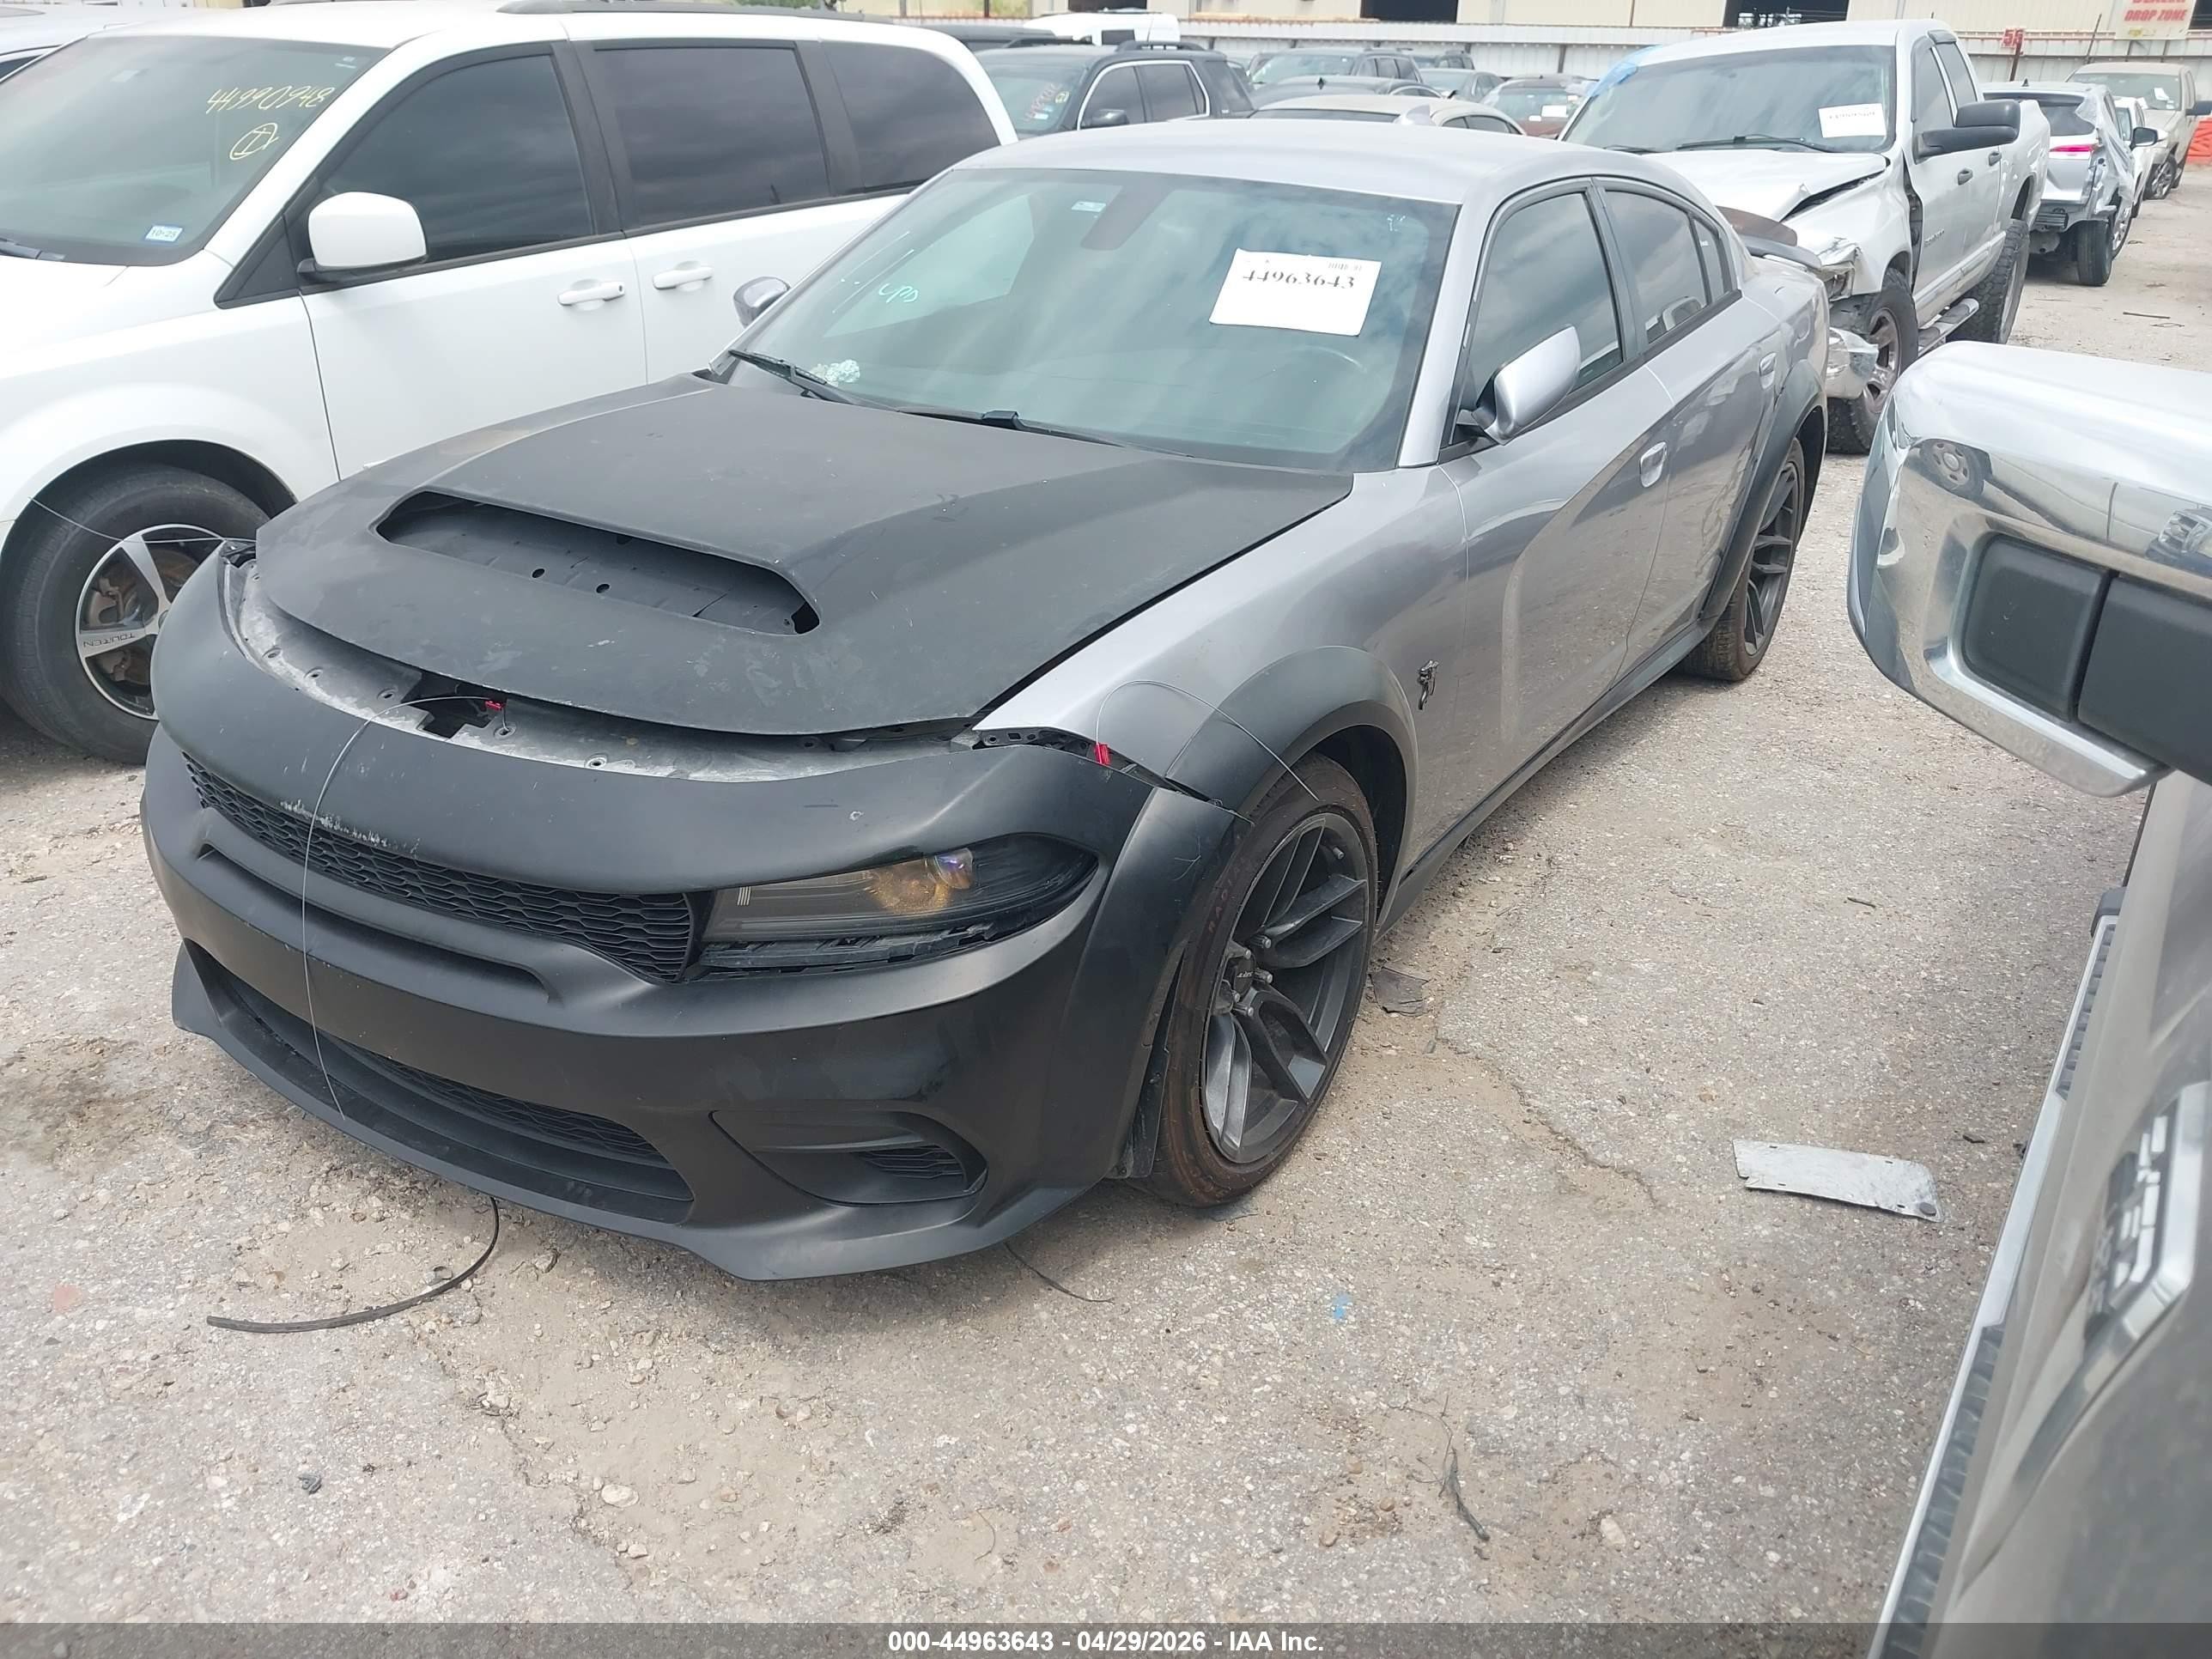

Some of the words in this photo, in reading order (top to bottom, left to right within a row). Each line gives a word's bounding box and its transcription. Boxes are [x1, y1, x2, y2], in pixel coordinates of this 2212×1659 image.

[2124, 9, 2157, 21] DROP
[2157, 9, 2187, 21] ZONE
[82, 632, 136, 648] TOUREN
